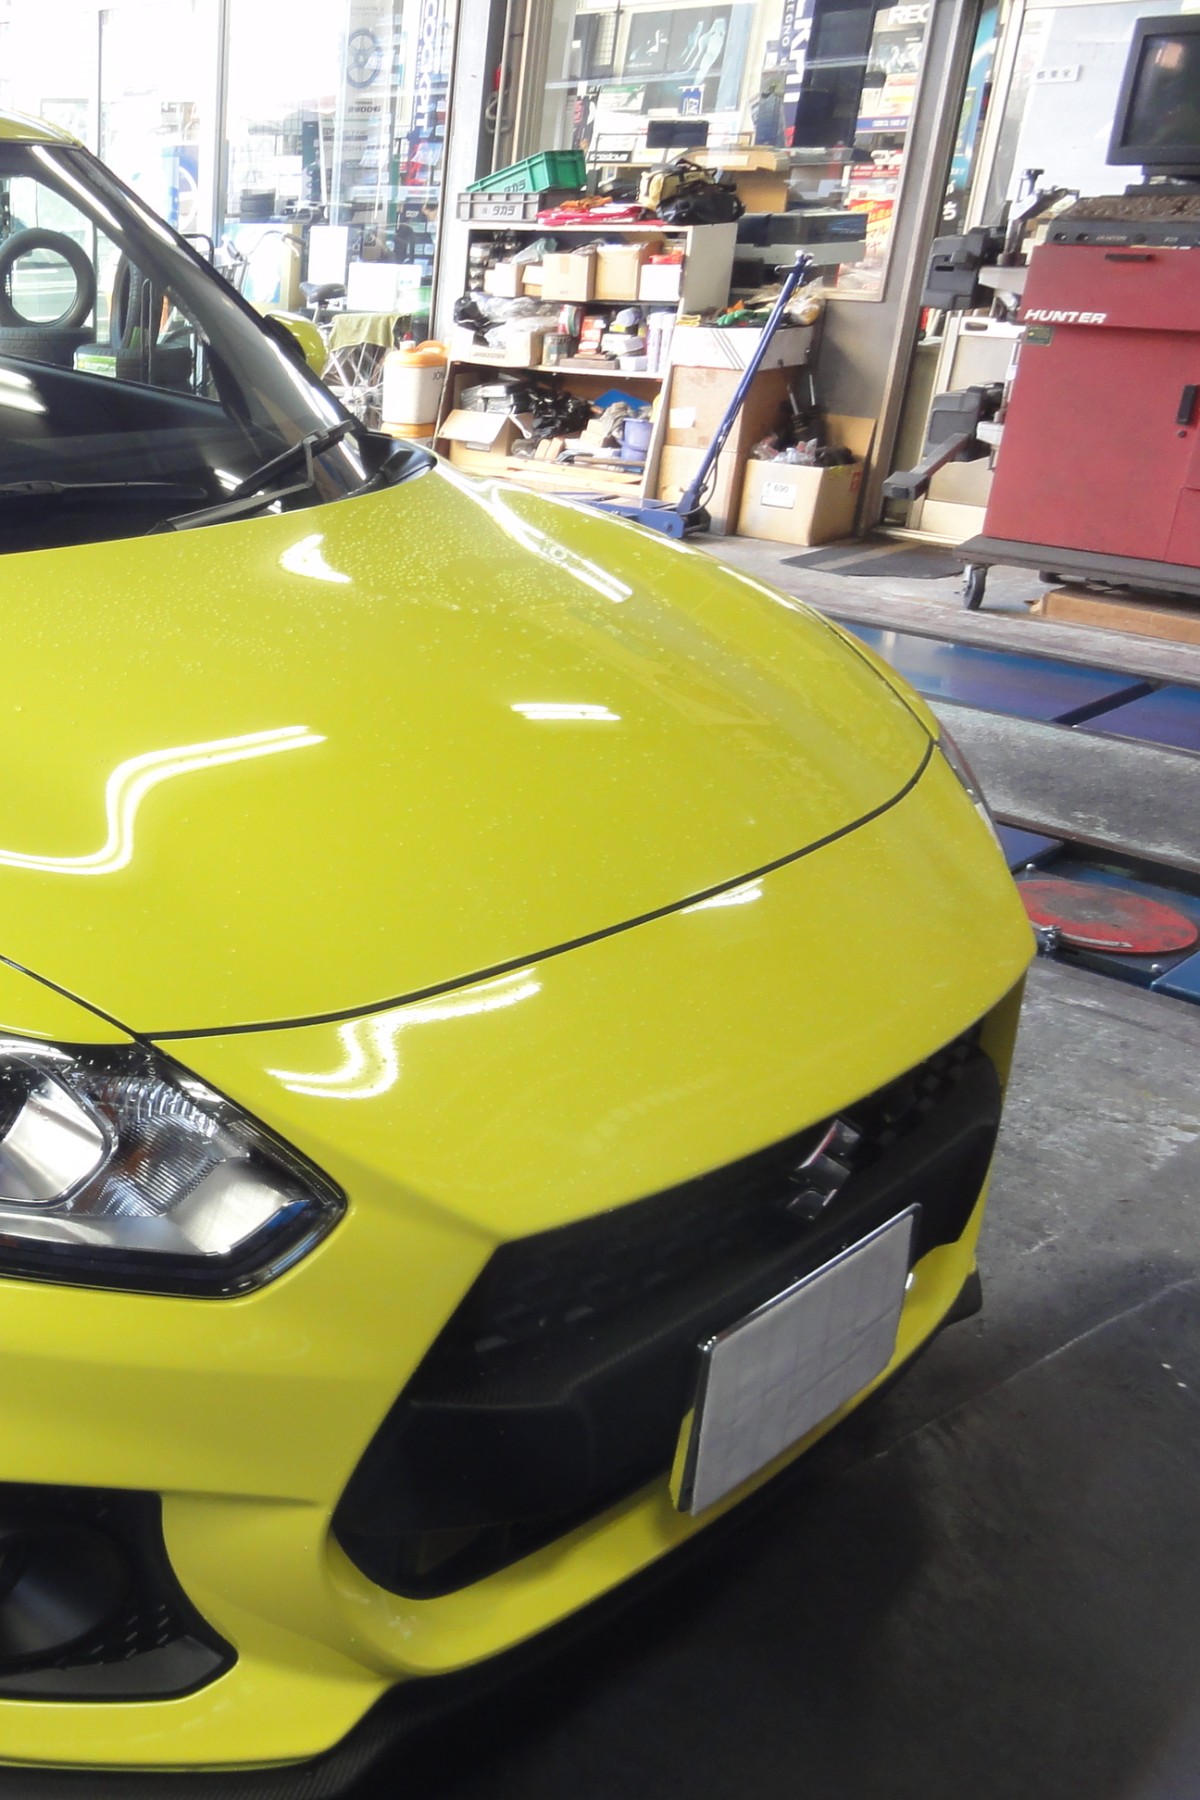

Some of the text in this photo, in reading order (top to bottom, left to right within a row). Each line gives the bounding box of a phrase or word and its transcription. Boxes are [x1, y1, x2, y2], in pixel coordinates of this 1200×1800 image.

[492, 205, 516, 216] タカラ
[1024, 309, 1108, 324] HUNTER
